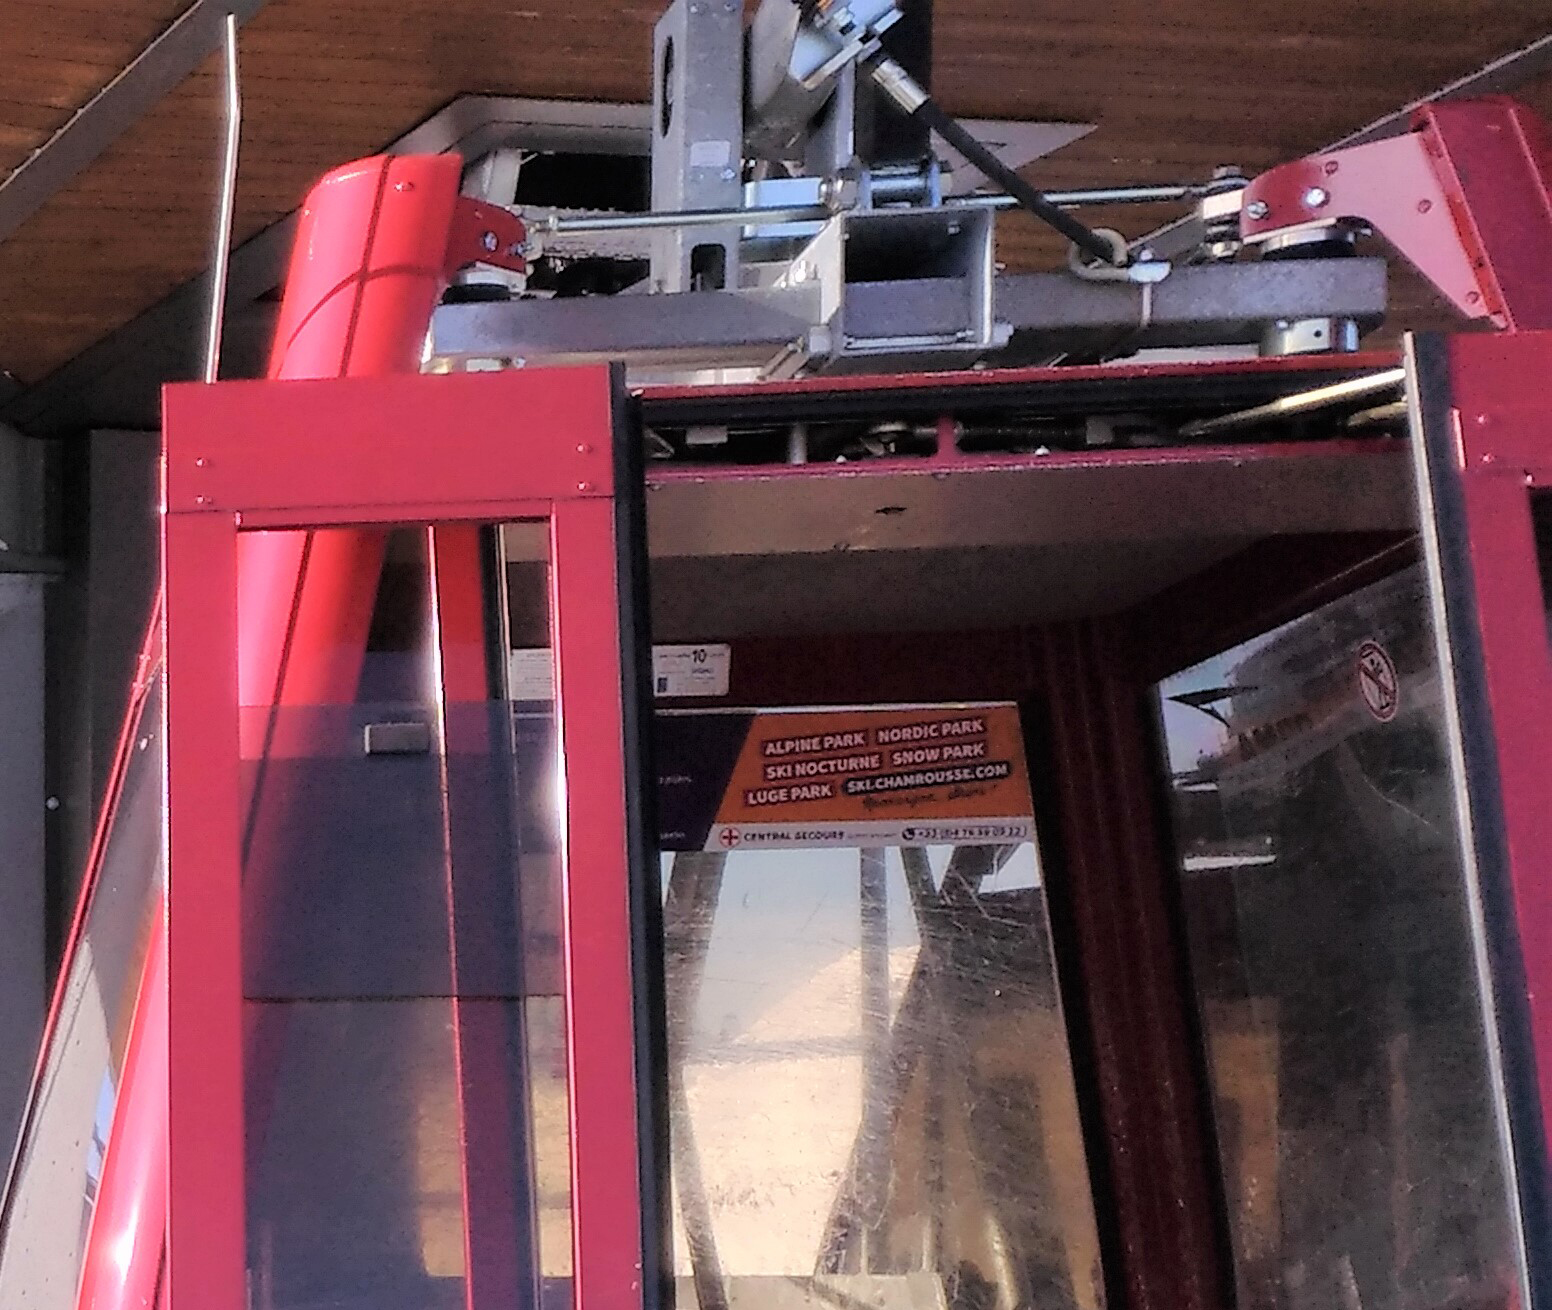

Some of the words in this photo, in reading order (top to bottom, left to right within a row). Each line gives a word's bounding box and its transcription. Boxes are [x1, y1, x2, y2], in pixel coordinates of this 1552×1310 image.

[764, 735, 821, 756] ALPINE
[823, 731, 865, 751] PARK
[878, 722, 938, 744] NORDIC
[941, 718, 984, 739] PARK
[892, 747, 940, 766] SNOW
[943, 742, 984, 761] PARK
[766, 763, 792, 780] SKI
[794, 754, 880, 776] NOCTURNE
[847, 763, 1009, 794] SKI.CHAMROUSSE.COM
[747, 789, 788, 806] LUGE
[790, 783, 832, 802] PARK
[744, 831, 792, 841] CENTRAL
[794, 830, 845, 841] SECOURS
